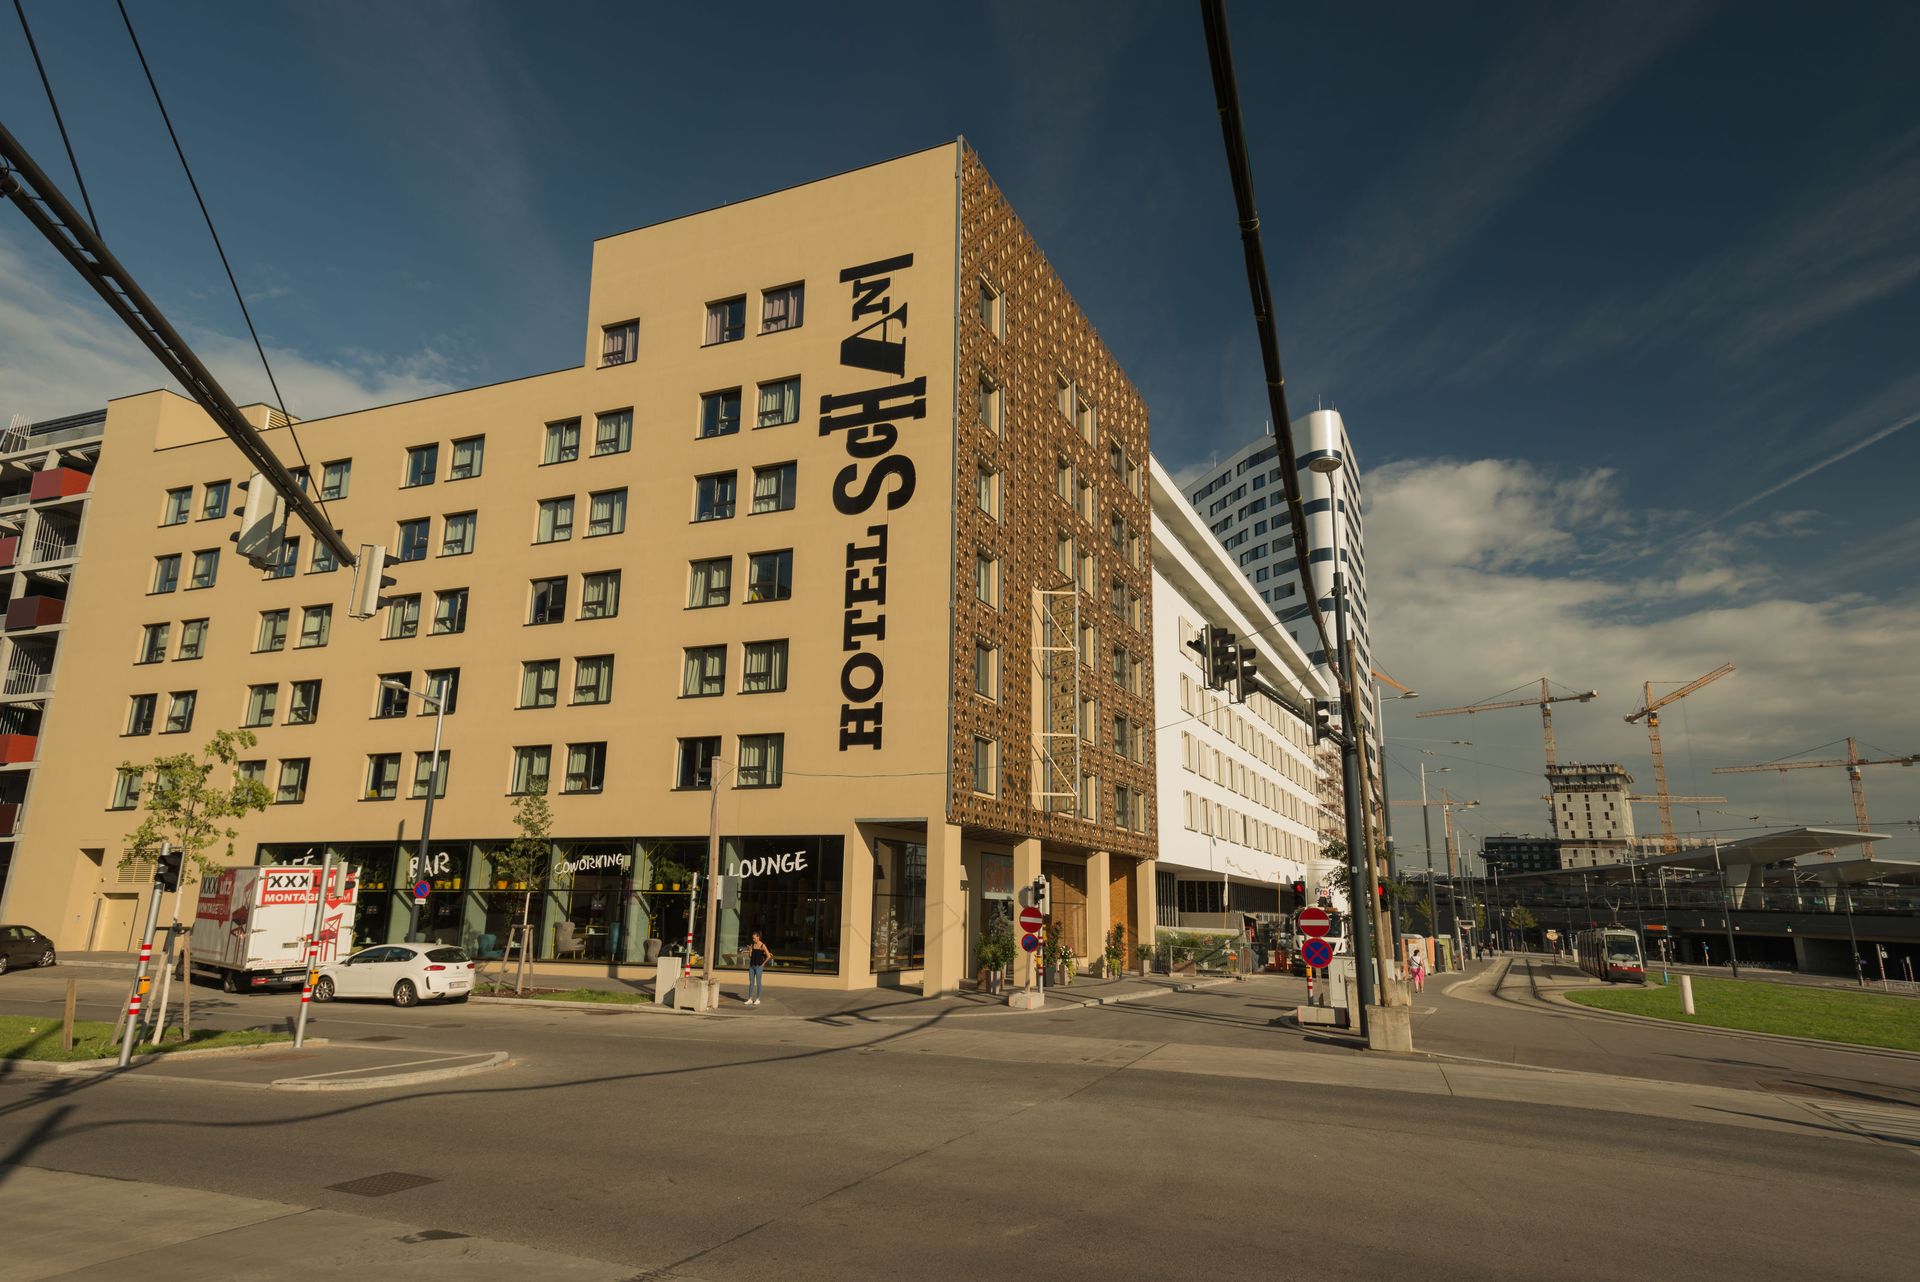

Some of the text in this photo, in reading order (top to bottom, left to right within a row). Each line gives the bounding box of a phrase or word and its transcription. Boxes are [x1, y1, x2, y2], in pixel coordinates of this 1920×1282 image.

[839, 523, 888, 752] HOTEL
[408, 851, 451, 878] BAR
[553, 853, 625, 875] COWORKING
[728, 850, 809, 879] LOUNGE
